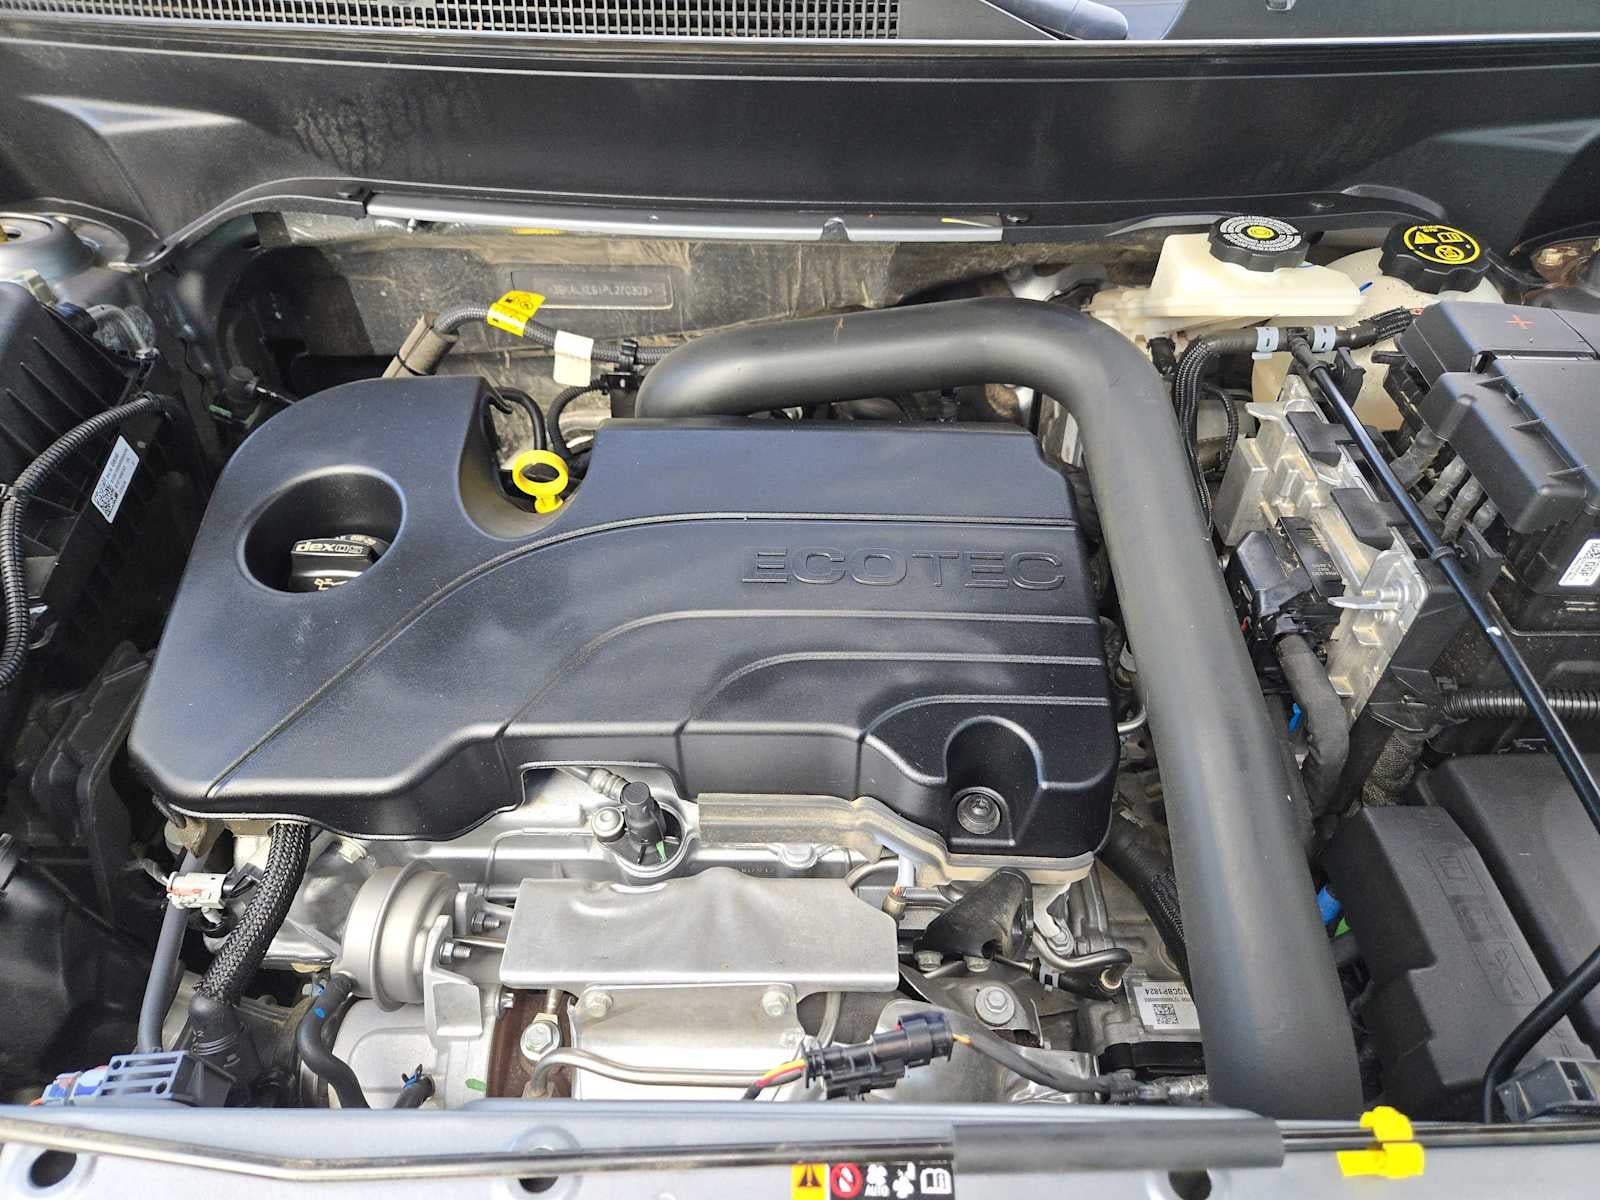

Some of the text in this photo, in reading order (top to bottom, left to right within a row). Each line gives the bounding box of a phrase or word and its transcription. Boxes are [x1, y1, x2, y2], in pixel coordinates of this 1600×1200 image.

[296, 542, 363, 554] dexos
[742, 546, 1066, 591] ECOTEC
[864, 1184, 890, 1197] AUTO
